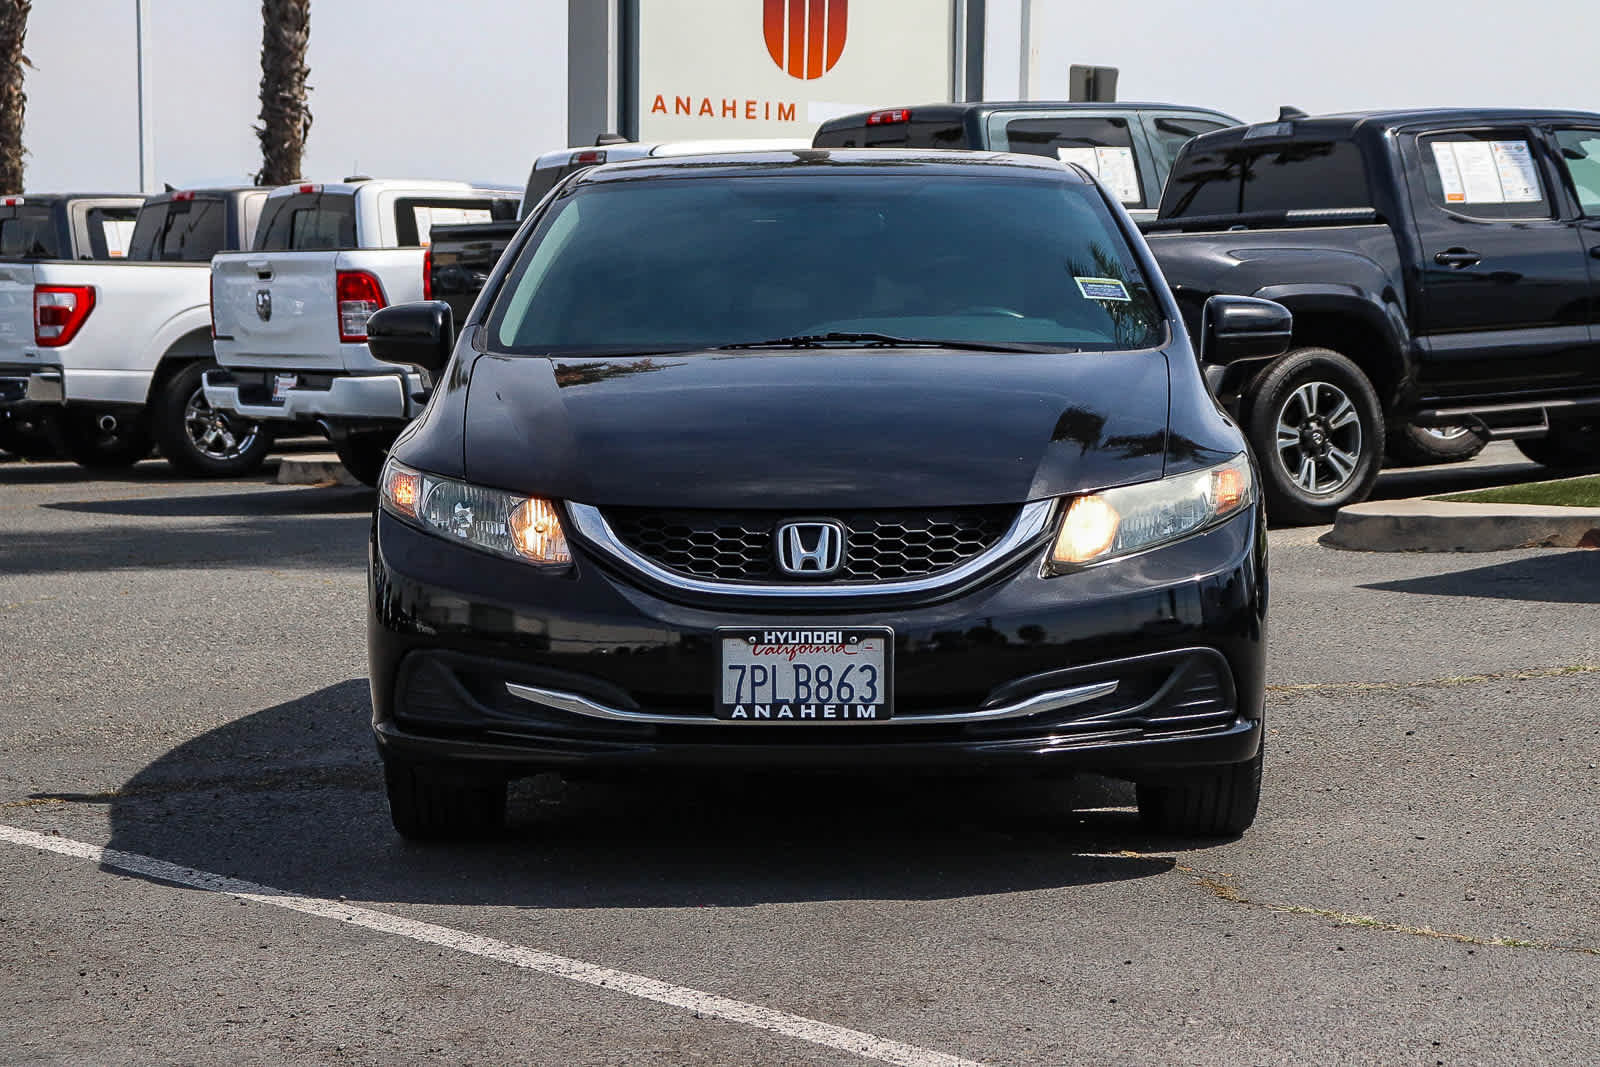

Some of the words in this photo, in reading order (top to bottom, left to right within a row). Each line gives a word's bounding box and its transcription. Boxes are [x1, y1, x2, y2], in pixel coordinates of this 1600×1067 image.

[651, 94, 796, 121] ANAHEIM
[763, 631, 843, 644] HYUNDAI
[752, 643, 858, 661] California
[728, 664, 878, 703] 7PLB863
[731, 704, 876, 718] ANAHEIM
